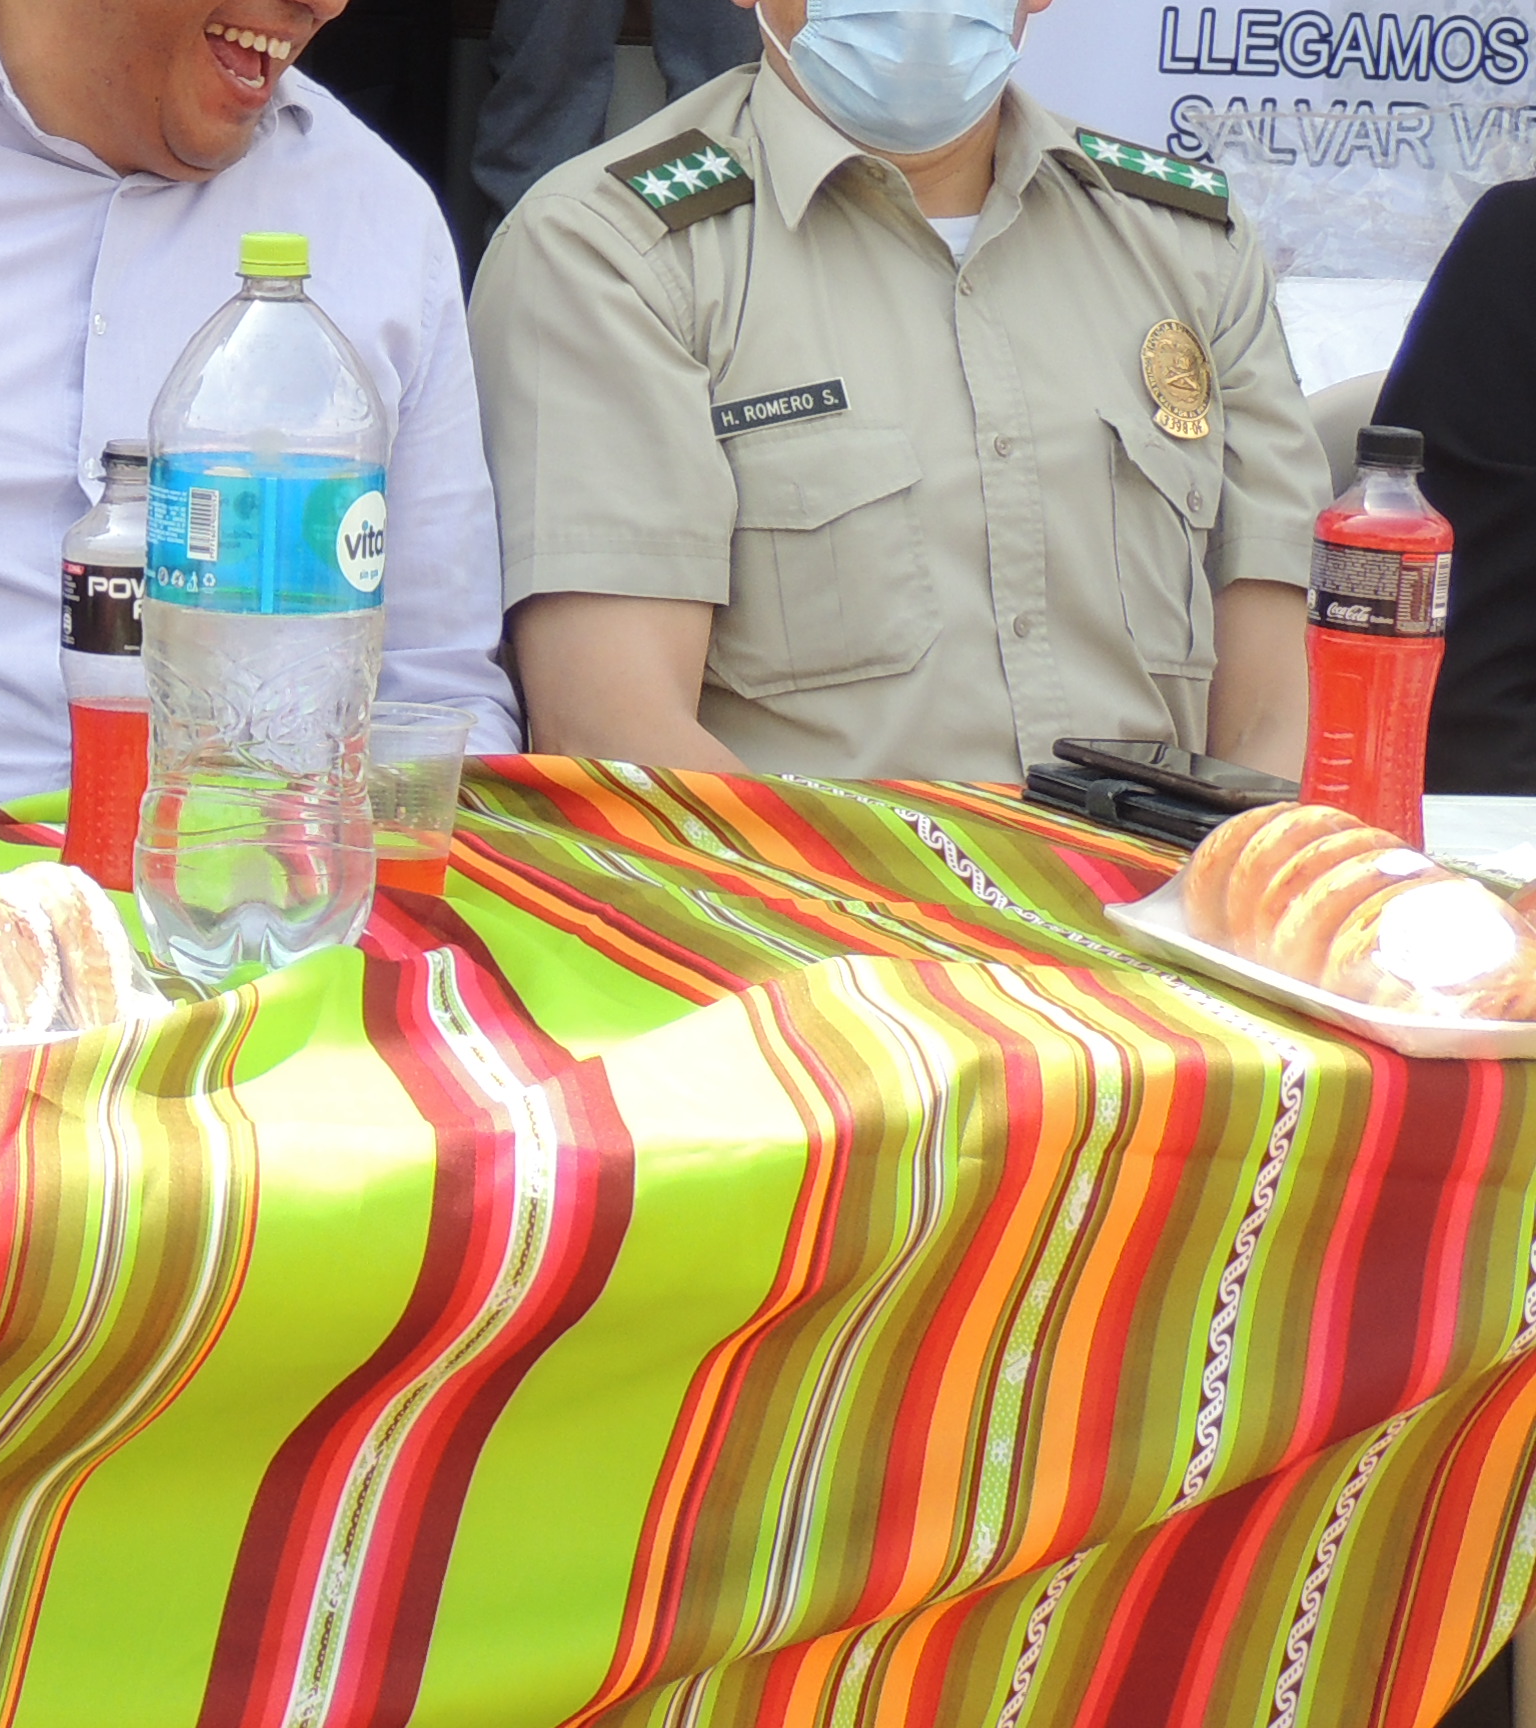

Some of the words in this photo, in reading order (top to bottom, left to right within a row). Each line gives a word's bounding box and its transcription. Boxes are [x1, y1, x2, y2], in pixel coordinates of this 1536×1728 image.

[1159, 6, 1528, 85] LLEGAMOS
[1167, 95, 1436, 170] SALVAR
[720, 409, 740, 428] H.
[743, 393, 815, 423] ROMERO
[820, 388, 840, 409] S.
[345, 520, 386, 560] vita
